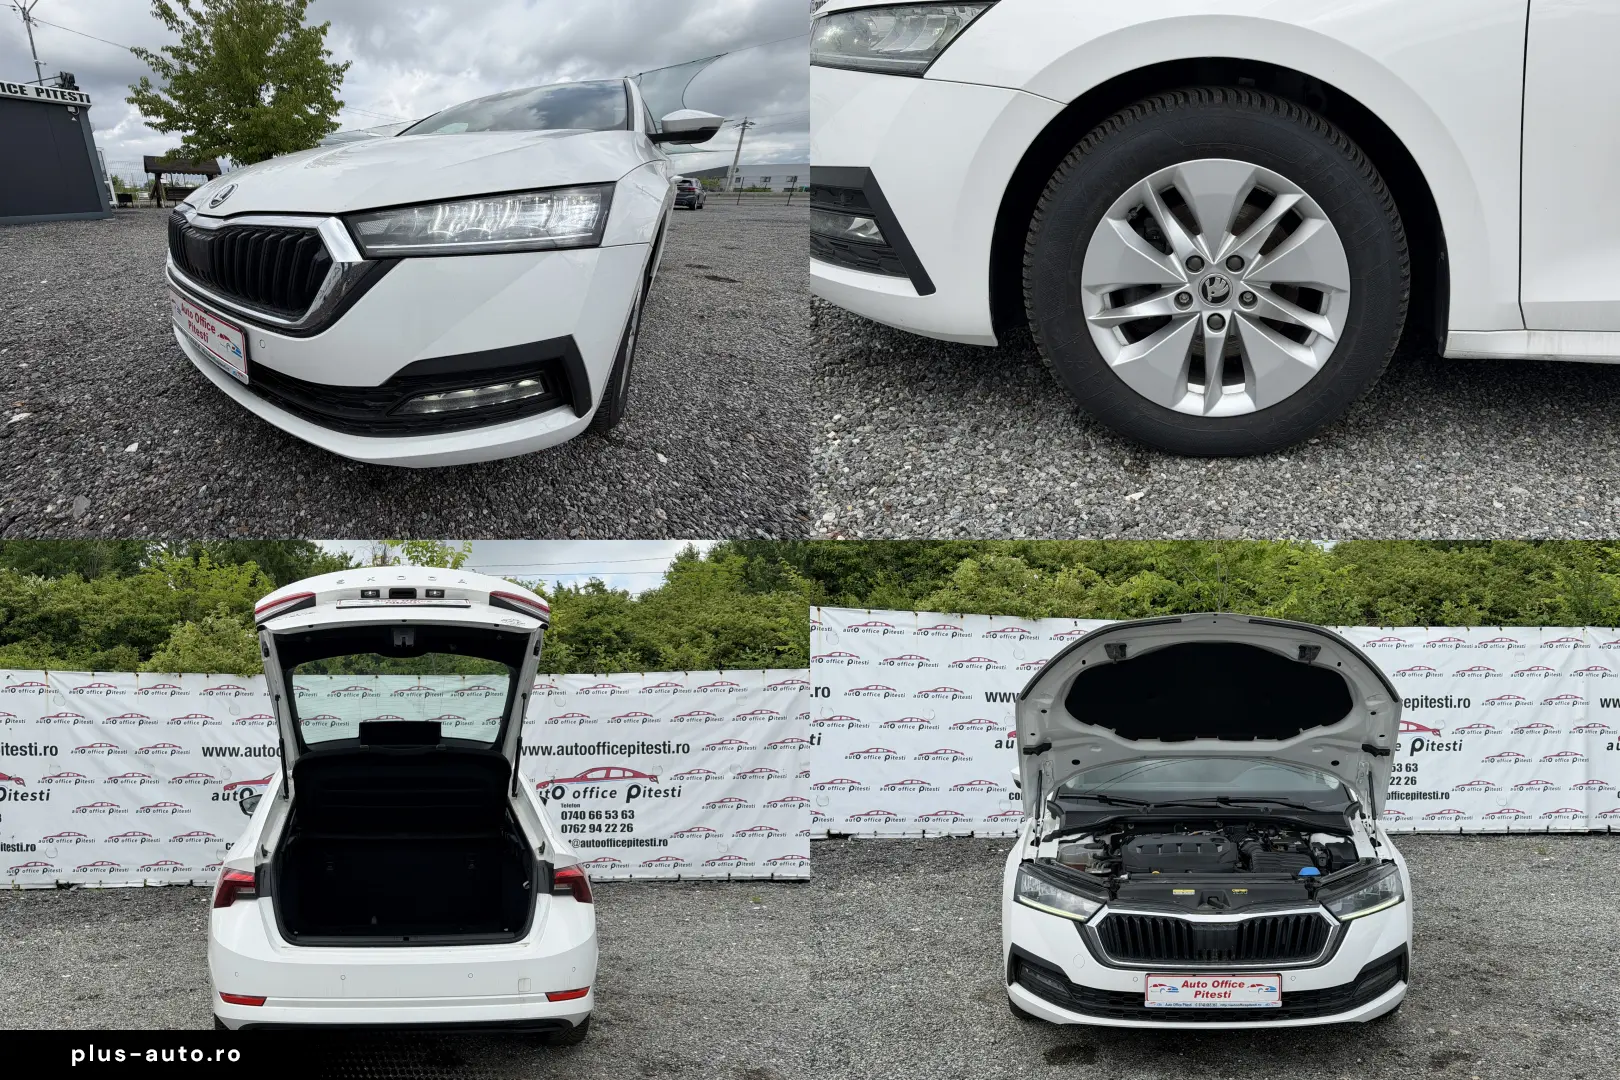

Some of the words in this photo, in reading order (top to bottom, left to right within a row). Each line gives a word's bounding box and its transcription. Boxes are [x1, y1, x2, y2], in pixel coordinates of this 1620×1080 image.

[34, 87, 91, 103] PITESTI
[181, 303, 193, 319] Auto
[195, 313, 216, 334] Office
[188, 320, 208, 343] Pitesti
[1405, 763, 1418, 772] 63
[1390, 776, 1401, 785] 22
[1404, 776, 1417, 785] 26
[572, 787, 617, 799] office
[561, 810, 586, 820] 0740
[589, 810, 602, 820] 66
[604, 810, 618, 820] 53
[621, 810, 635, 819] 63
[561, 824, 586, 833] 0762
[589, 824, 602, 833] 94
[605, 824, 617, 832] 22
[620, 823, 633, 832] 26
[1181, 980, 1208, 988] Auto
[1211, 980, 1245, 988] Office
[1194, 990, 1232, 999] Pitesti
